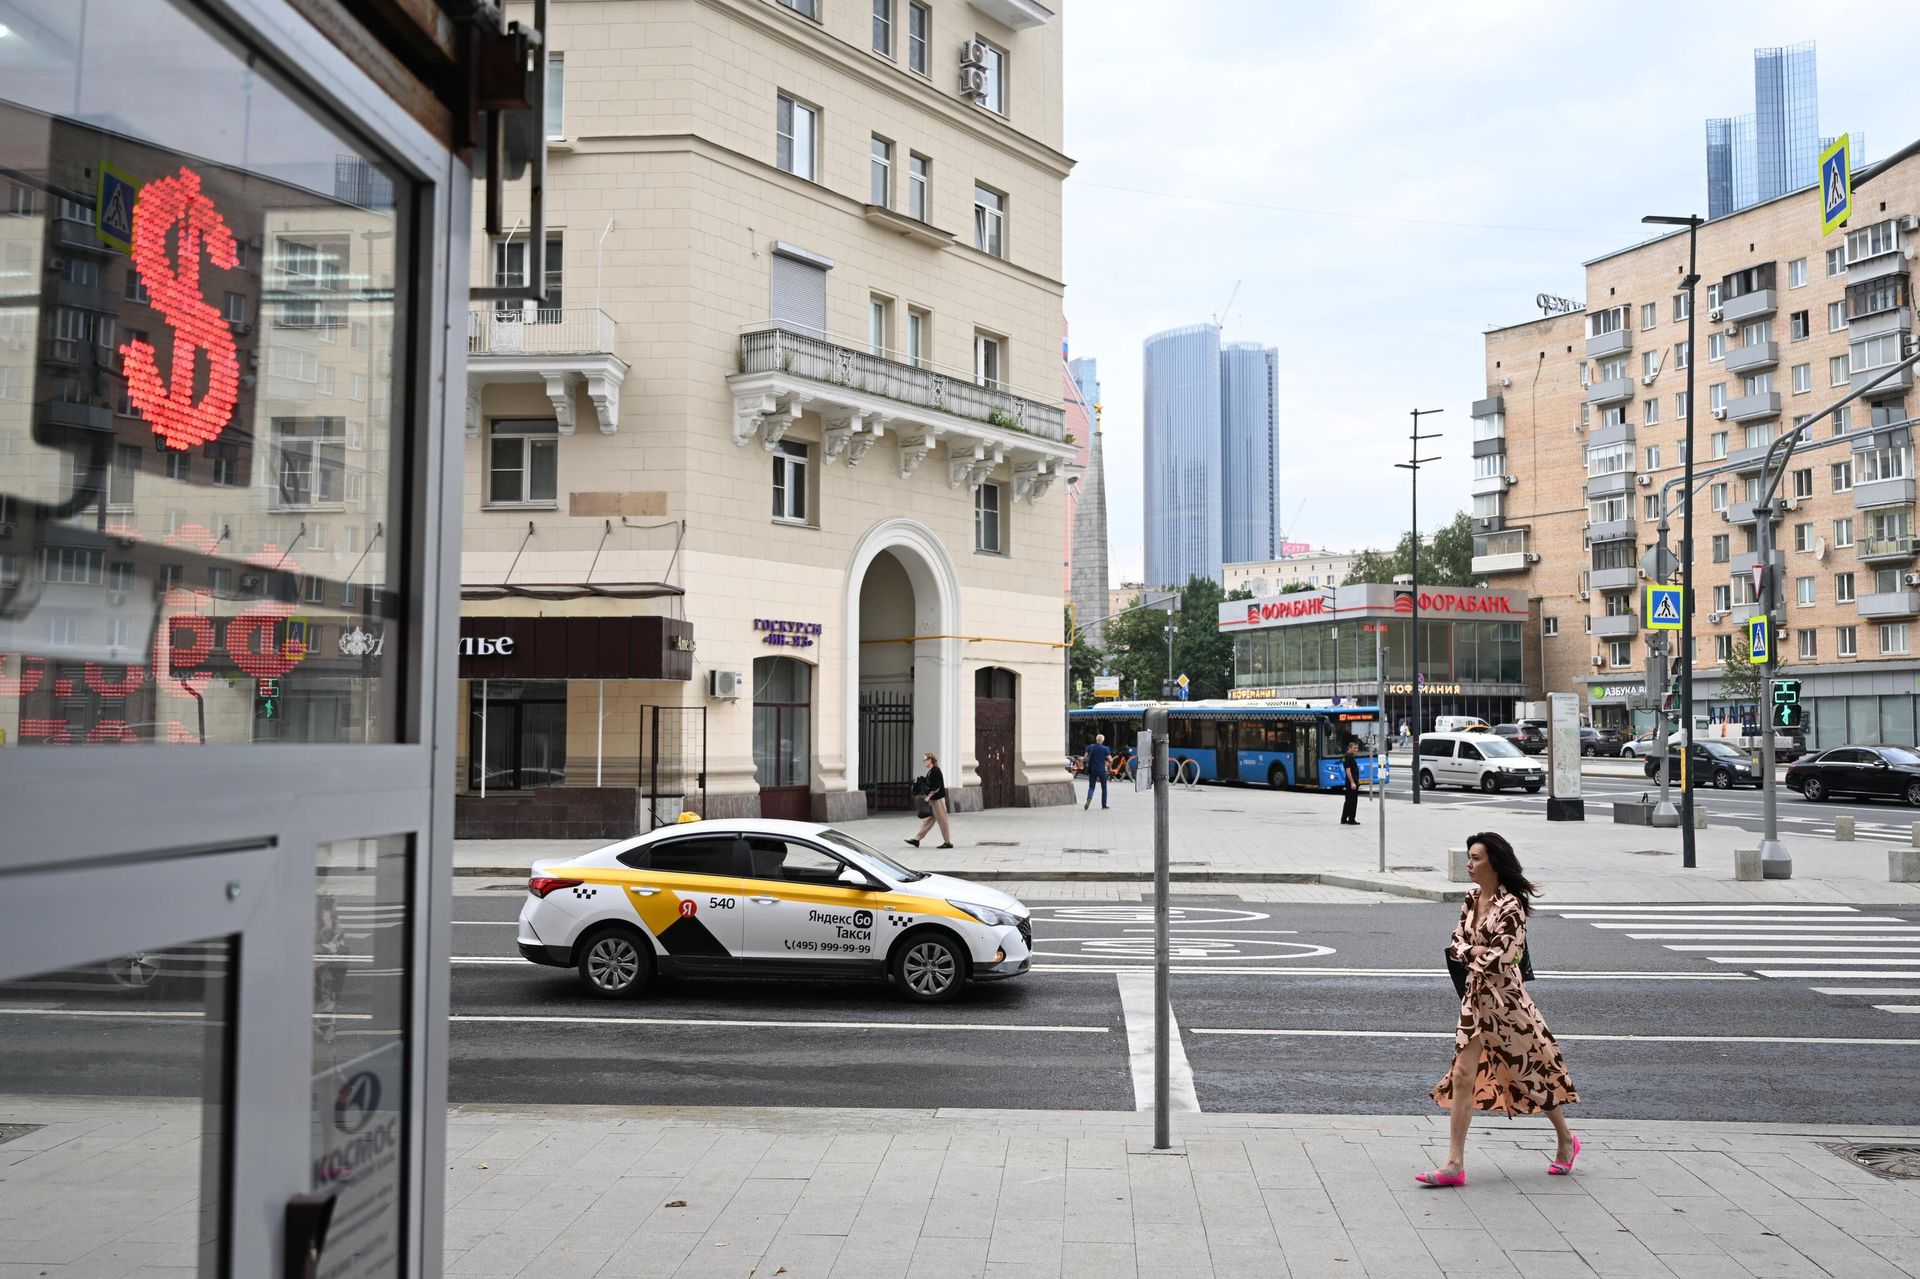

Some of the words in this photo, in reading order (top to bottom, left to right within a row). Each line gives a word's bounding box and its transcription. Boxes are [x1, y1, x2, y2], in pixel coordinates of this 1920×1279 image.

[119, 167, 241, 451] $
[1261, 597, 1325, 620] ФОРАБАНК
[1418, 592, 1512, 614] ФОРАБАНК
[1231, 689, 1277, 699] КОФЕМАНИЯ
[1389, 684, 1461, 695] КОФМАНИЯ
[682, 903, 692, 915] Я
[709, 897, 736, 910] 540
[808, 910, 852, 926] Яндекс
[856, 911, 872, 926] Go
[836, 925, 871, 941] Такси
[792, 940, 818, 951] (495)
[820, 941, 871, 954] 999-99-99
